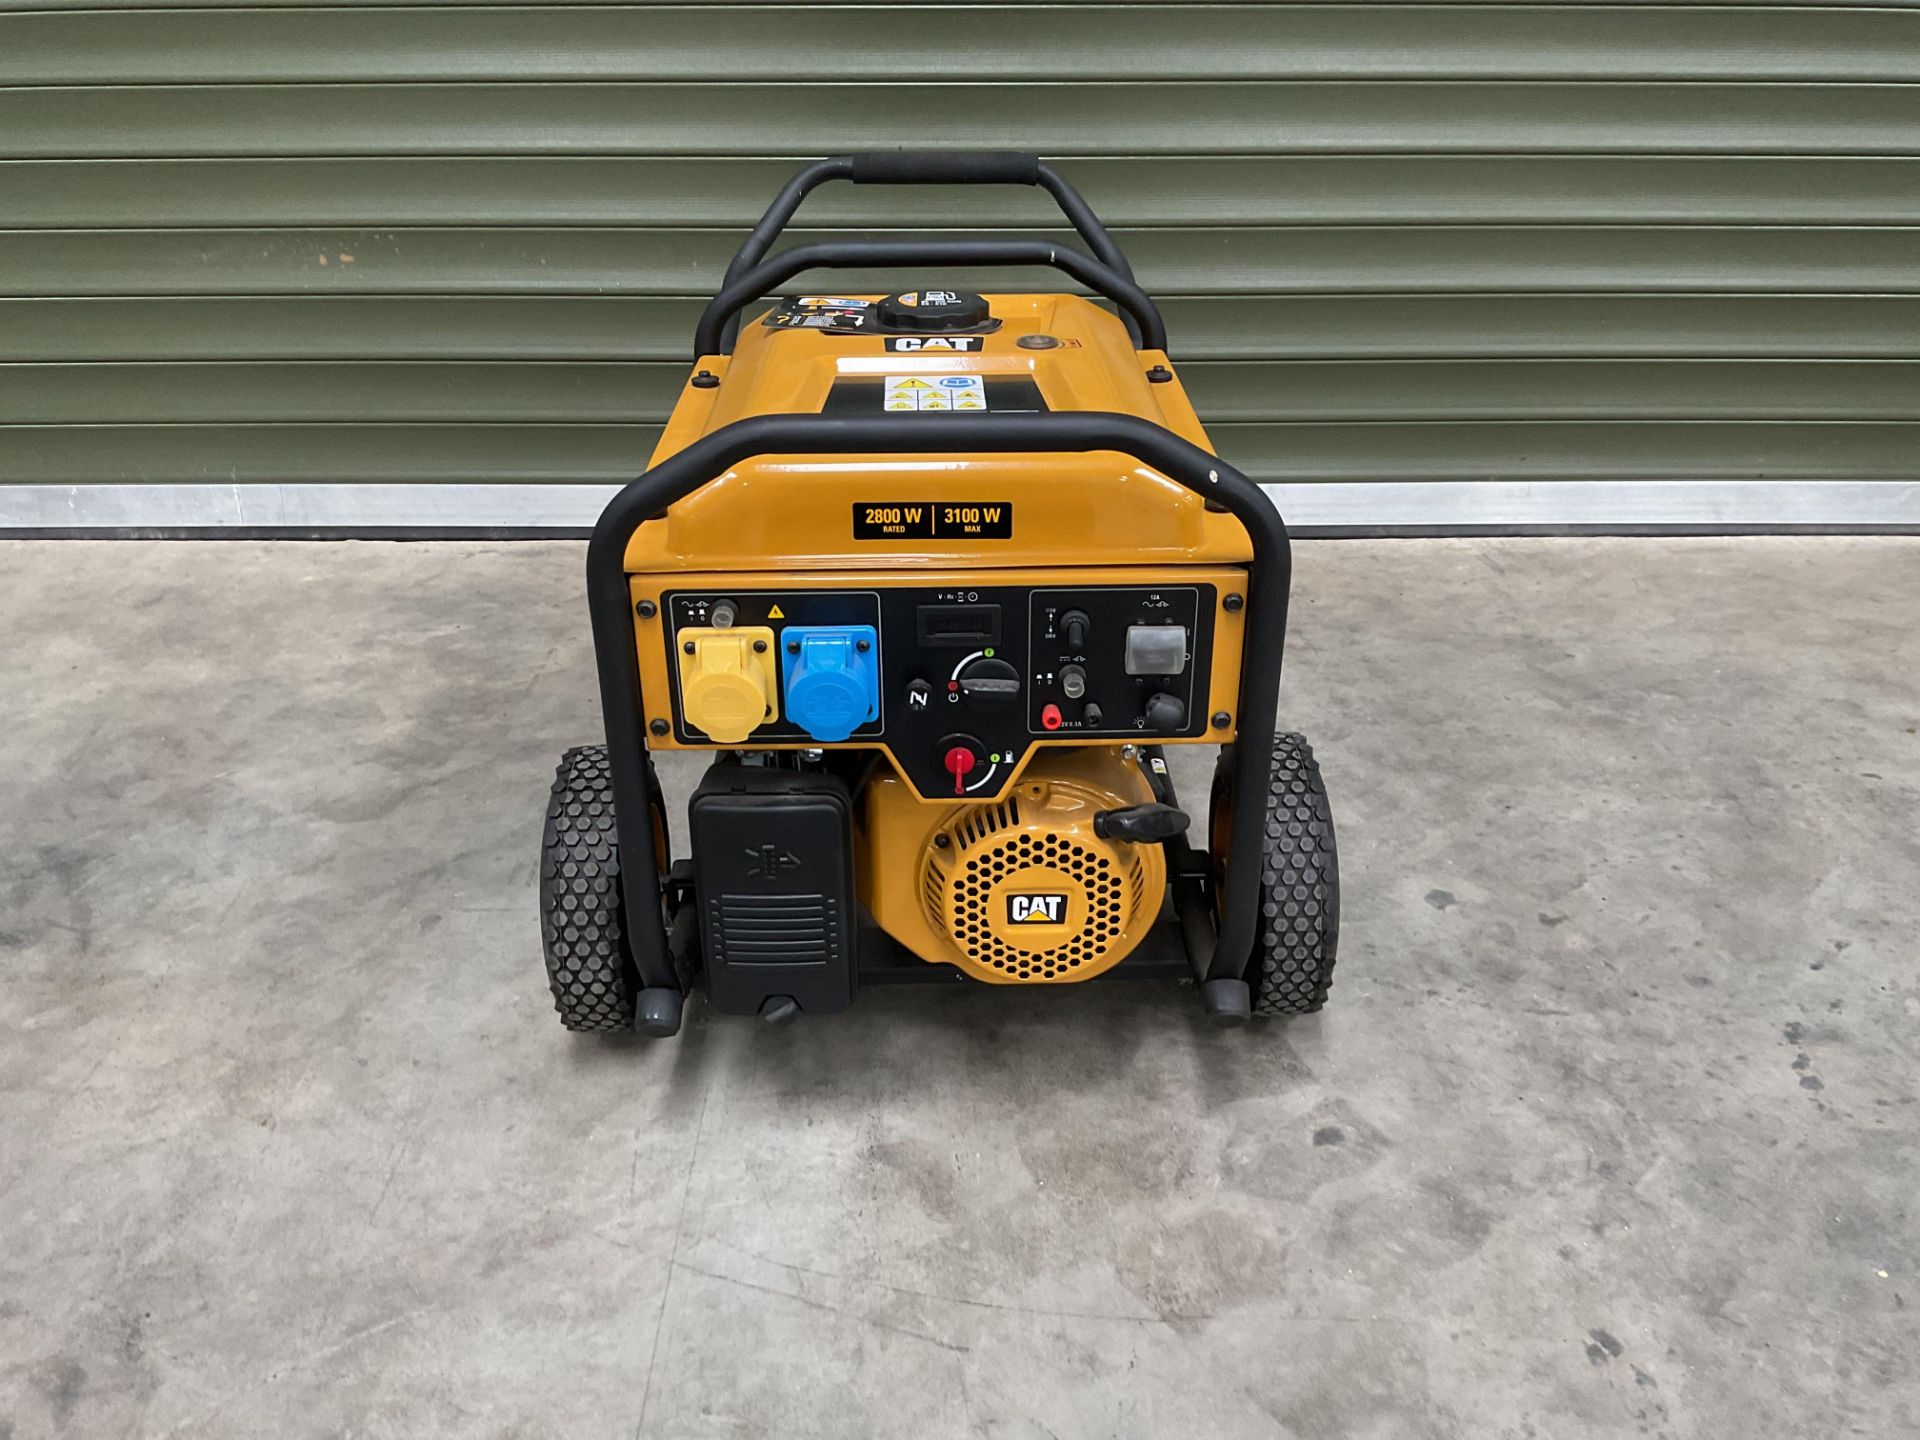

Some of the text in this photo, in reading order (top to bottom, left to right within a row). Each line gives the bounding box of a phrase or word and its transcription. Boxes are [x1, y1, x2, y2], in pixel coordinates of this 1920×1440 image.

[895, 337, 974, 352] CAT
[865, 508, 922, 524] 2800 W
[944, 507, 1001, 523] 3100 W
[883, 525, 906, 533] RATED
[964, 525, 981, 533] MAX
[1012, 896, 1062, 922] CAT
